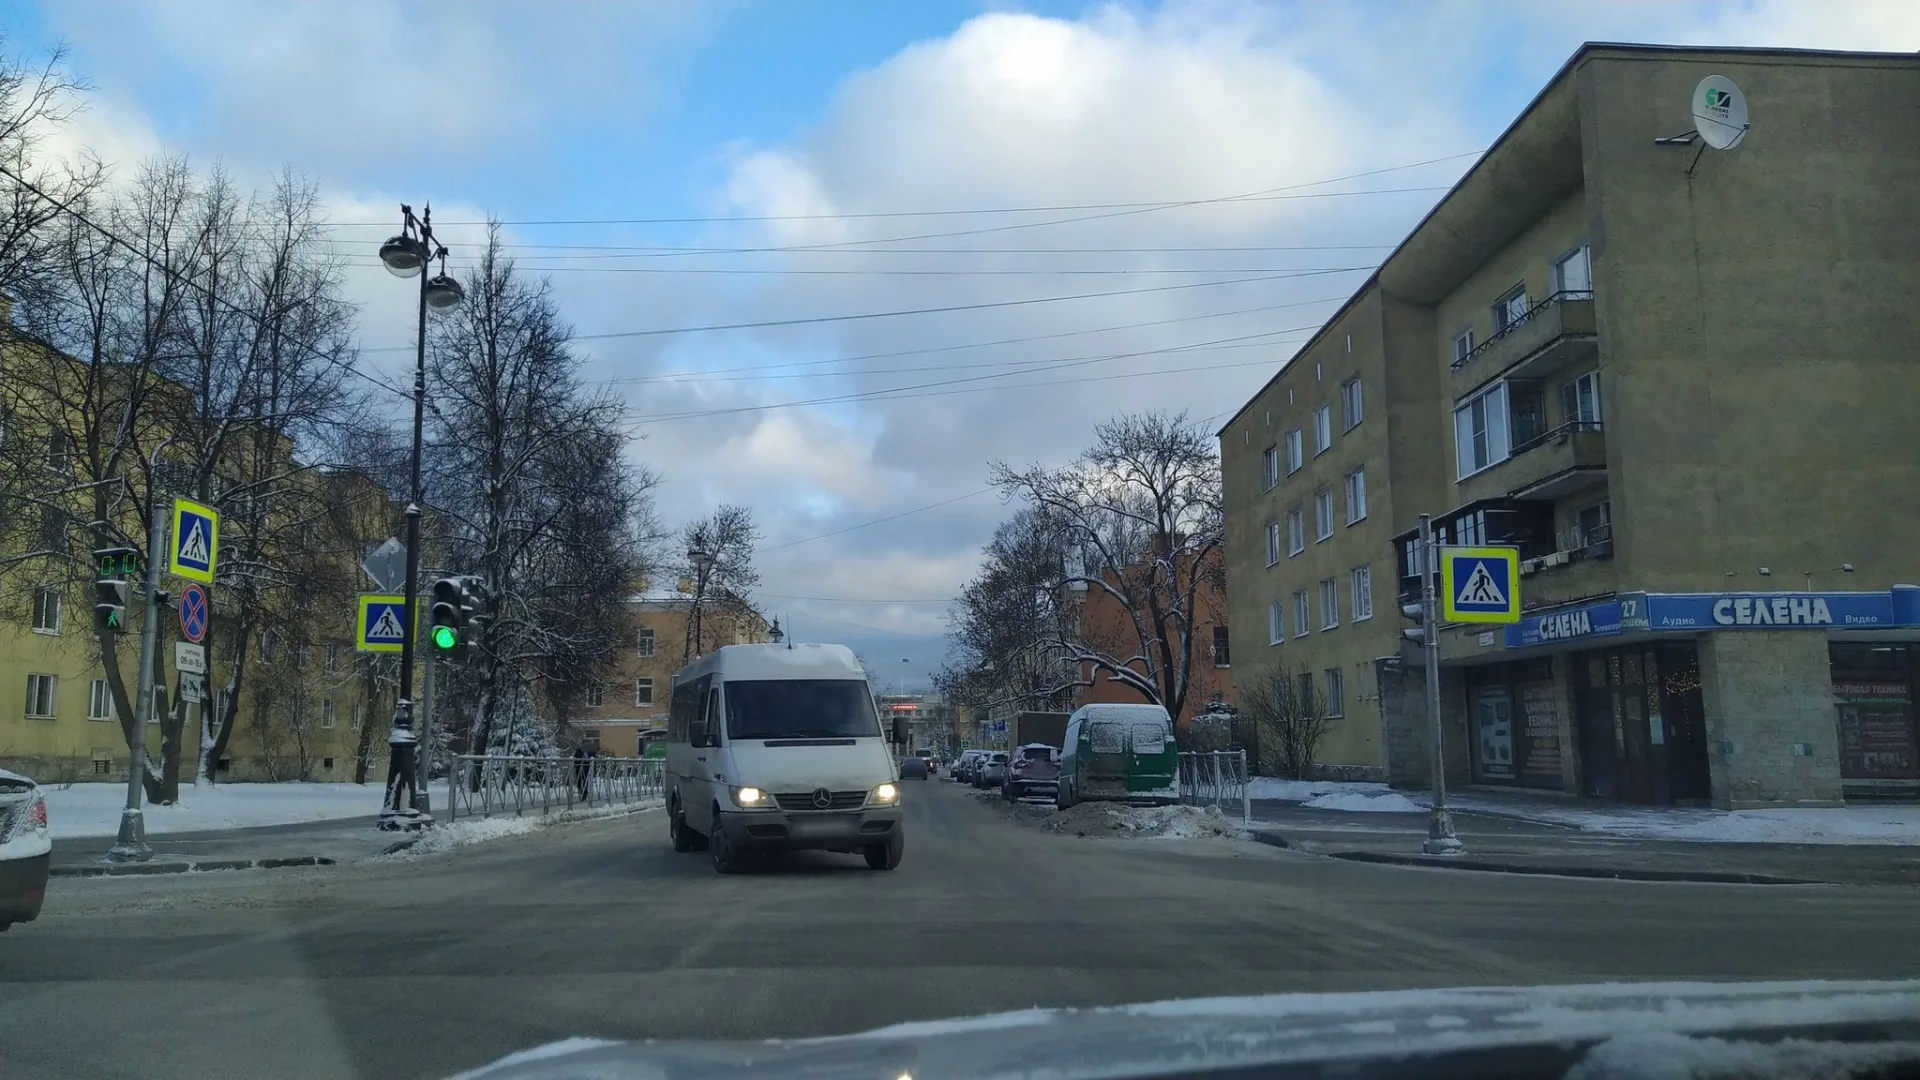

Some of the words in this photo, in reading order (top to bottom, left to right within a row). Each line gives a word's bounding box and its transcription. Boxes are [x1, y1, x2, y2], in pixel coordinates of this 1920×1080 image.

[1621, 600, 1637, 617] 27
[1713, 598, 1833, 625] СЕЛЕНА
[1539, 611, 1591, 641] СЕЛЕНА
[1662, 616, 1695, 629] Аудио
[1845, 614, 1878, 625] Видео
